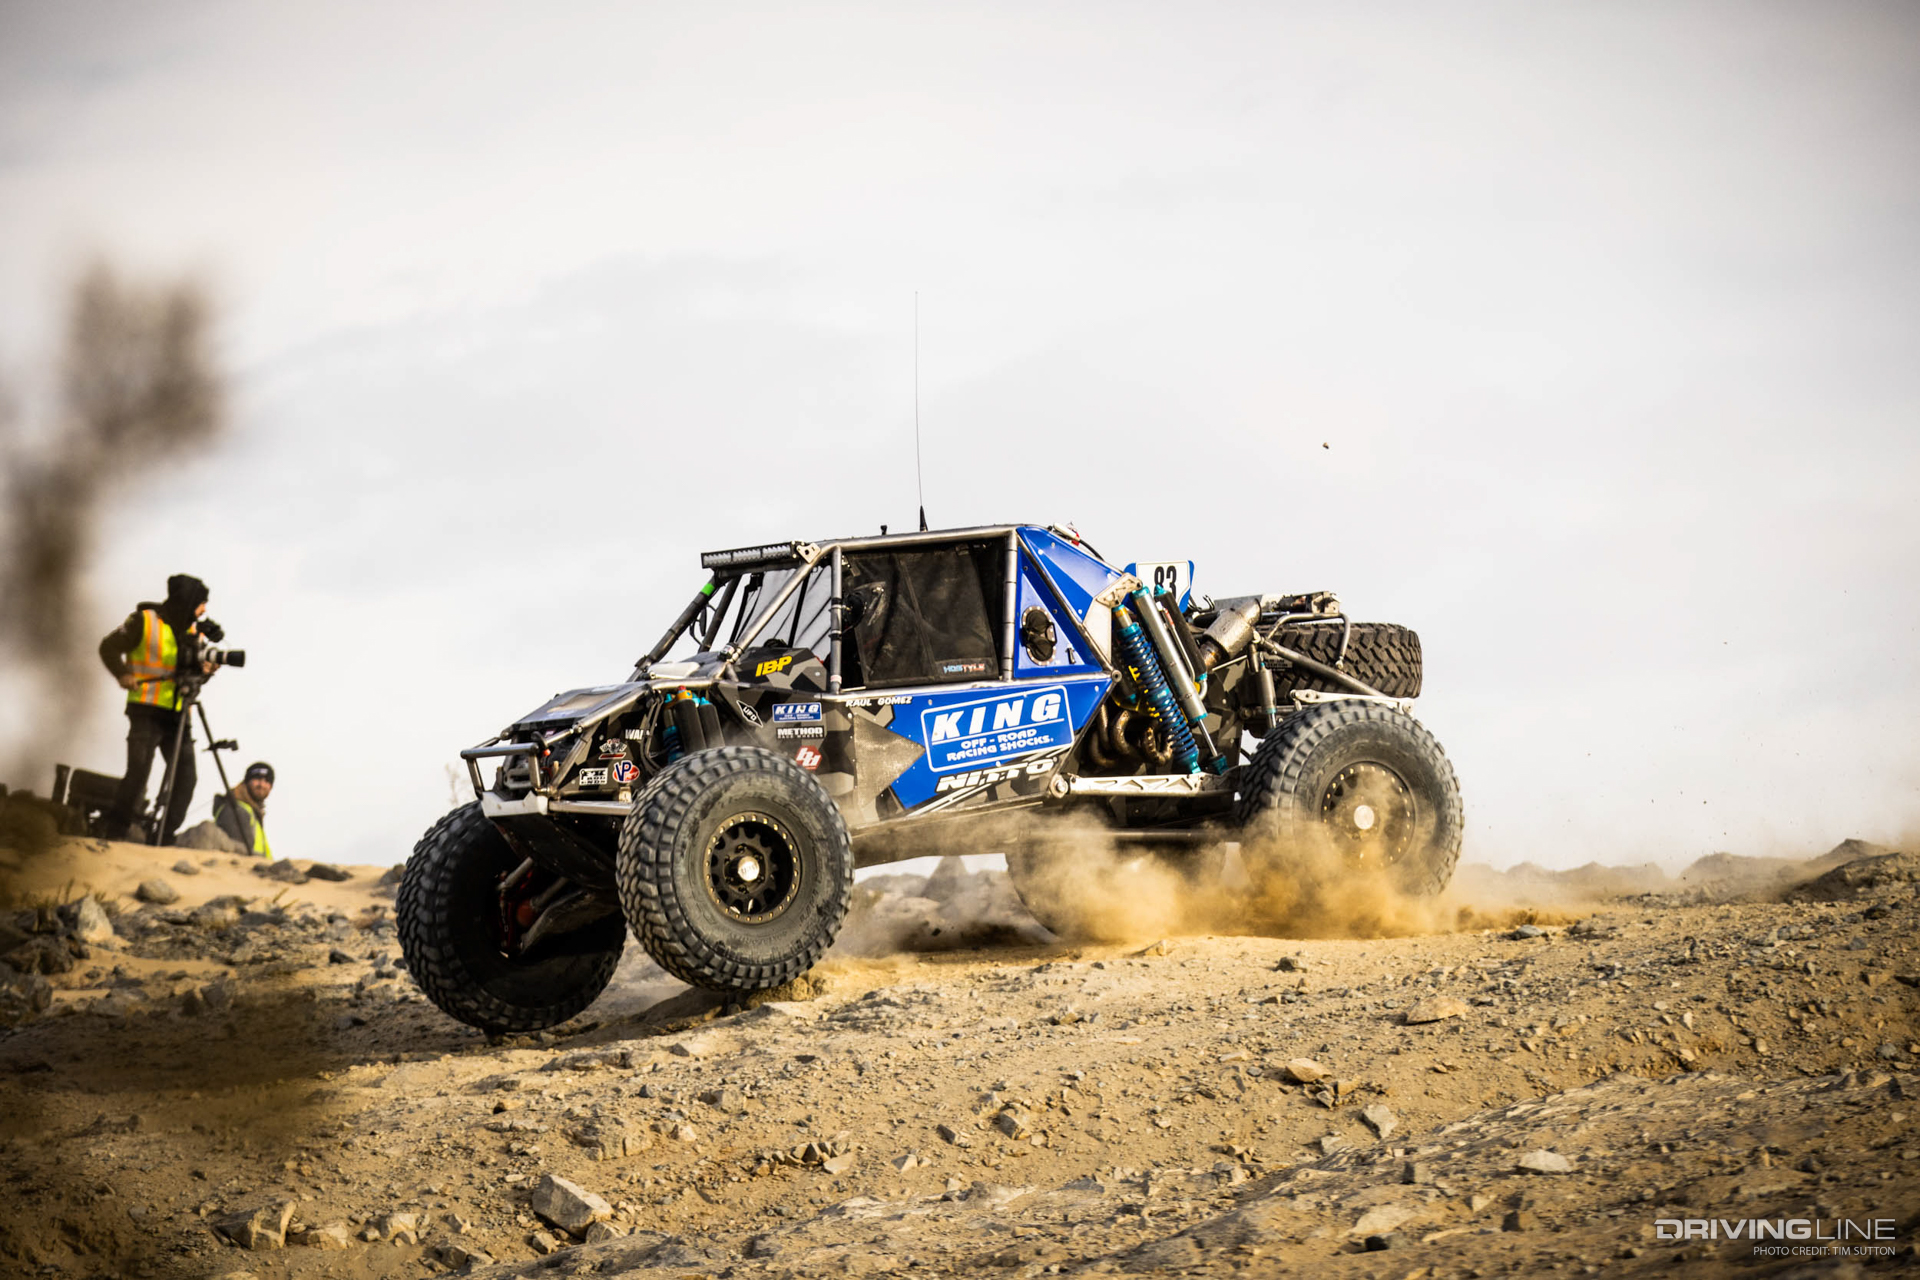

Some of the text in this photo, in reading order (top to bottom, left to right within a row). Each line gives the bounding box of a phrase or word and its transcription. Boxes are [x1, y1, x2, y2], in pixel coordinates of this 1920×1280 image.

[755, 655, 793, 677] IBP
[774, 704, 820, 715] KING
[845, 696, 913, 708] RAUL GOMEZ
[743, 706, 758, 721] UFO
[931, 693, 1062, 742] KING
[777, 727, 823, 736] METHOD
[961, 737, 987, 749] OFF
[997, 728, 1037, 743] ROAD
[946, 745, 998, 762] RACING
[614, 760, 633, 782] VP
[935, 758, 1055, 793] NITTO
